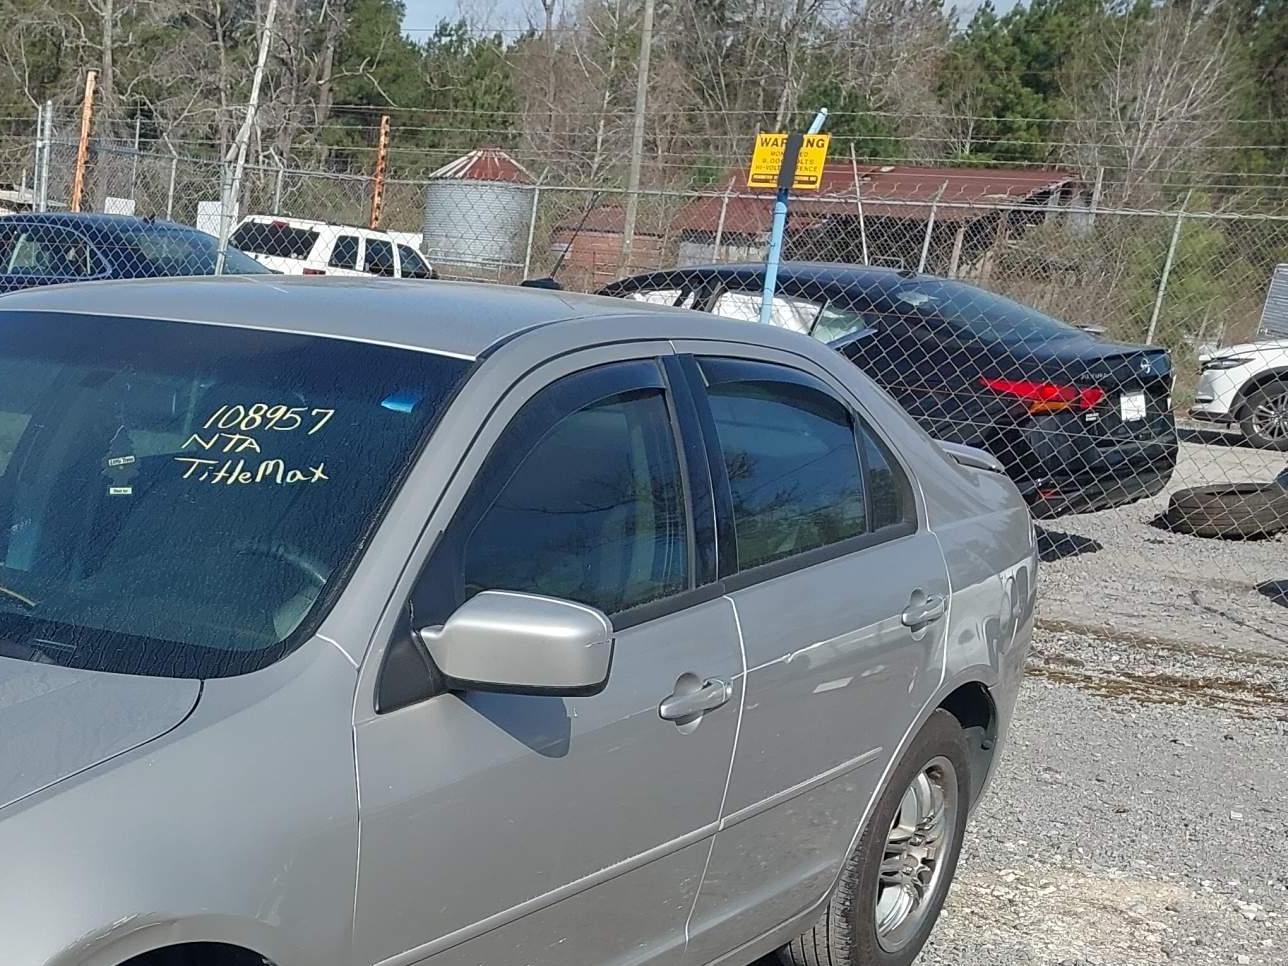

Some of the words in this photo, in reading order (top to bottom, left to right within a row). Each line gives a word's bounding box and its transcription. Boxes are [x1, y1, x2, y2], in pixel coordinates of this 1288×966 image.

[760, 138, 825, 148] WARNG
[203, 403, 335, 435] 108957
[181, 432, 261, 453] NTA
[174, 457, 329, 485] TitleMax
